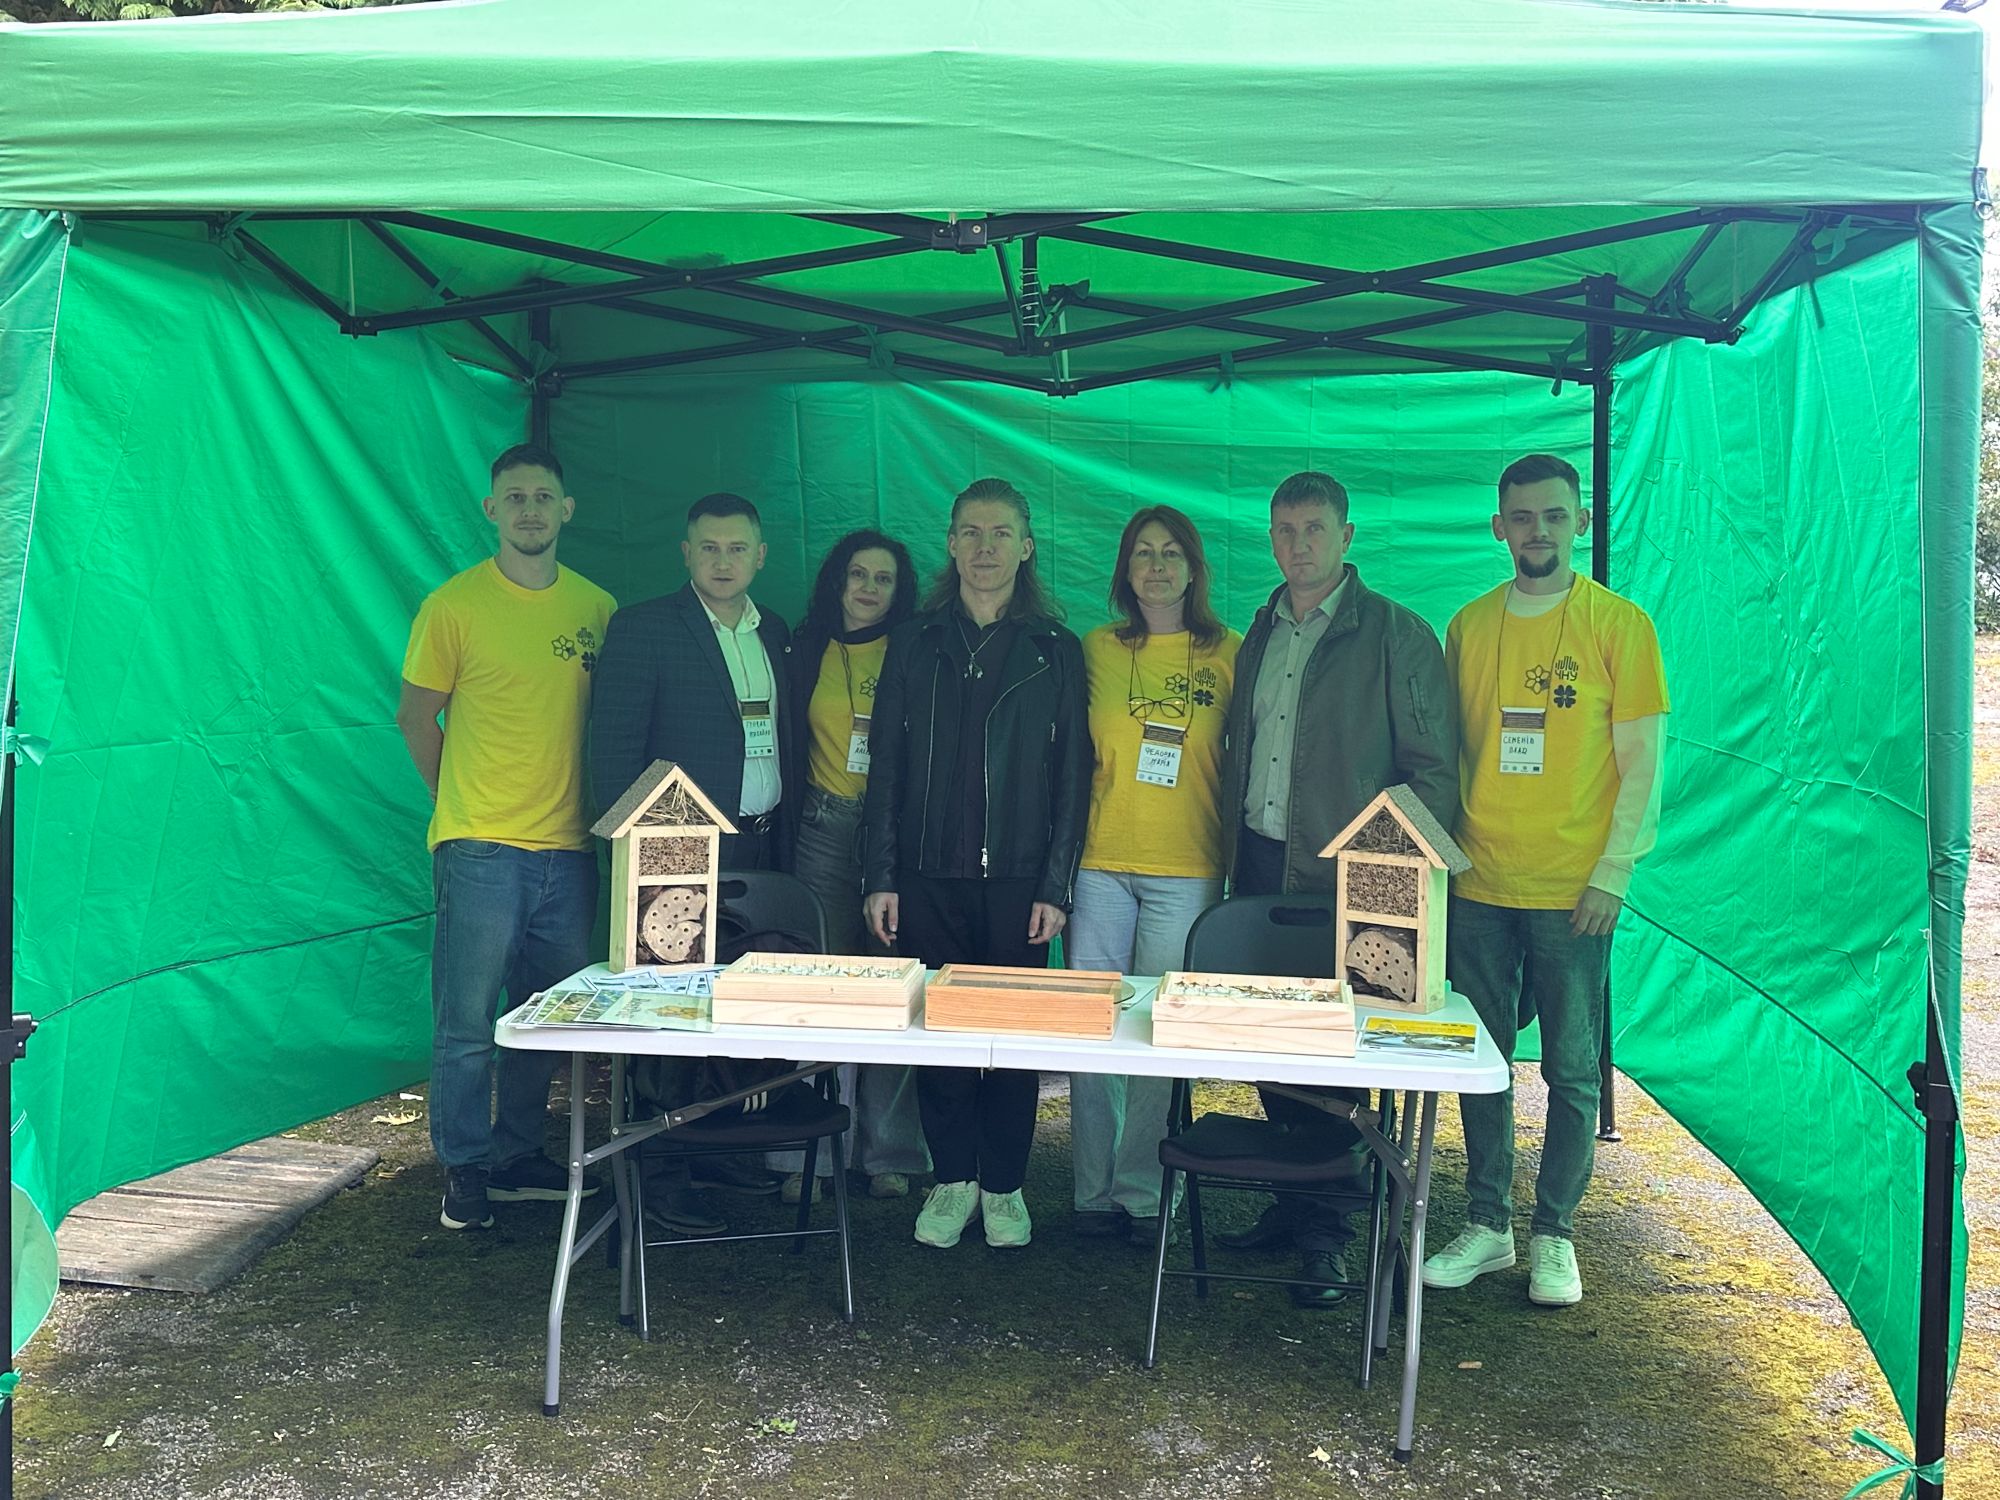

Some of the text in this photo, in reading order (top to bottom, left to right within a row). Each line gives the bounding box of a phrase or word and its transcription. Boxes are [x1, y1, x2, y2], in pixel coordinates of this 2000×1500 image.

[1555, 669, 1578, 681] ЧНУ
[1195, 677, 1216, 688] ЧНУ
[1503, 735, 1535, 744] СЕМЕНІВ
